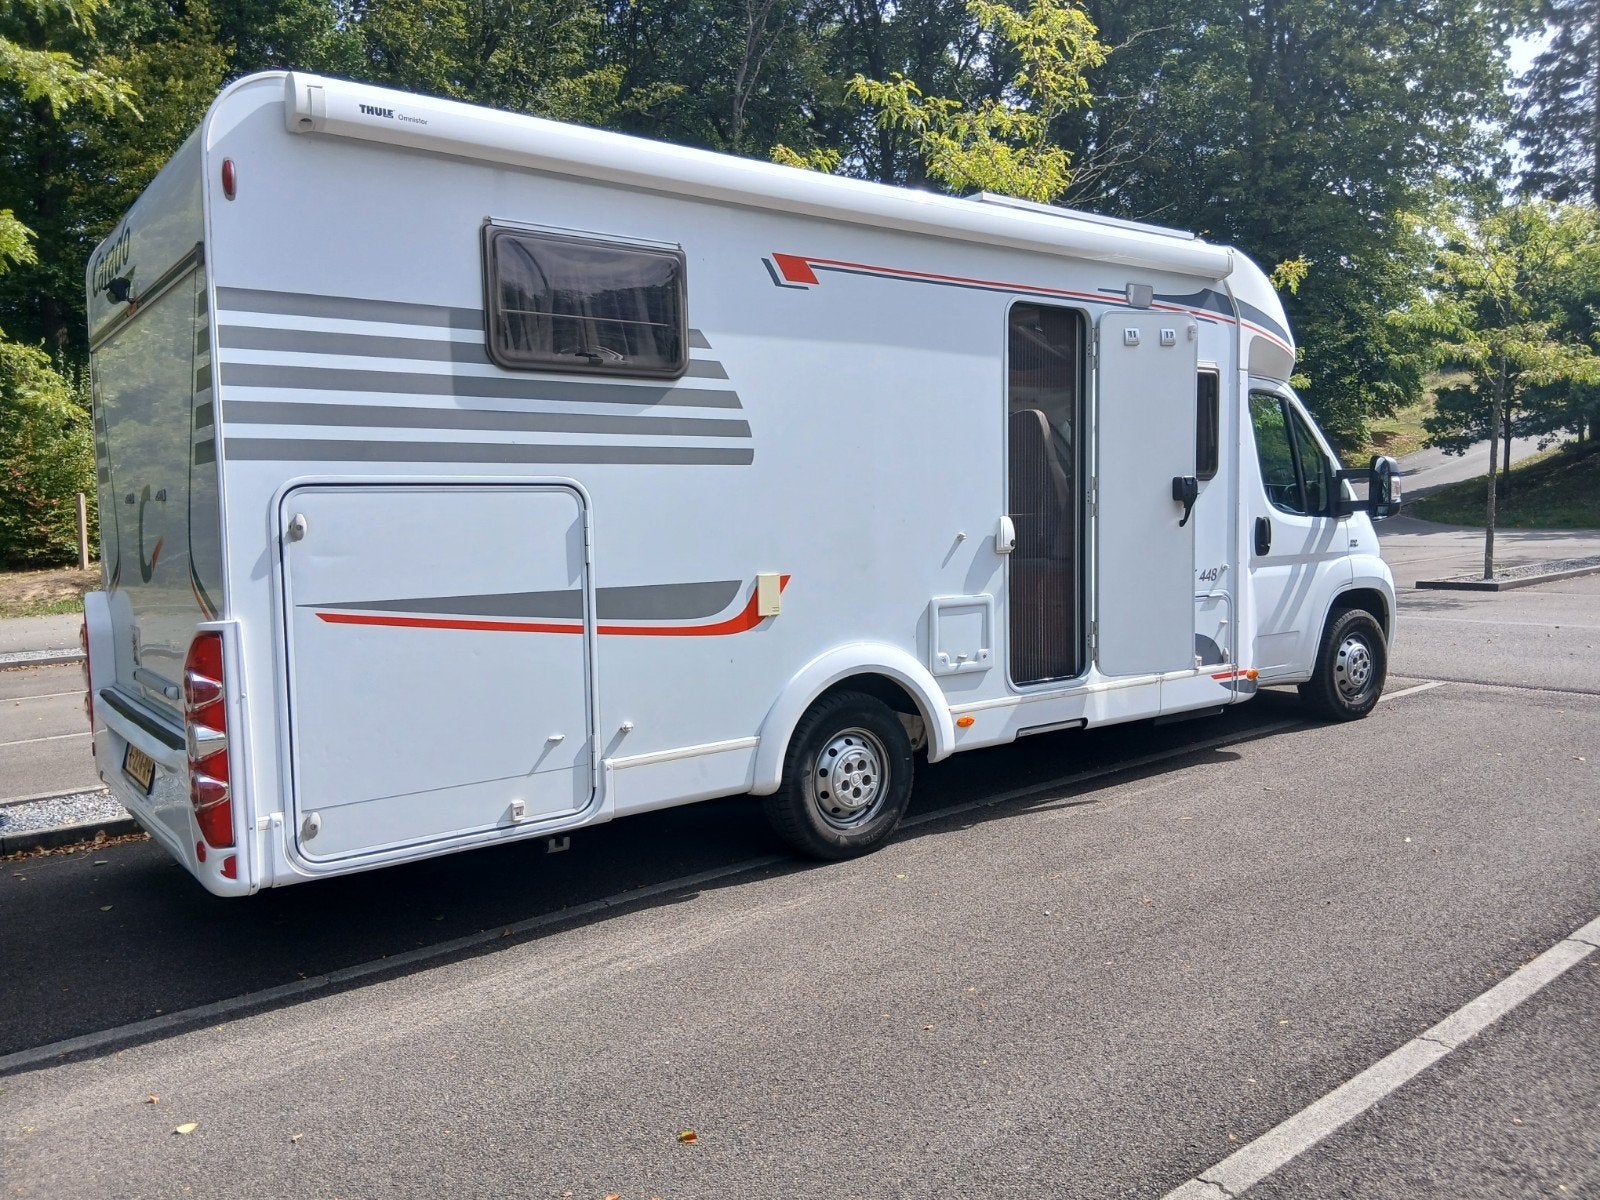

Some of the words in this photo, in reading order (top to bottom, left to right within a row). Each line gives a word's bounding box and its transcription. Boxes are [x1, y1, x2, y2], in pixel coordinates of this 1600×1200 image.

[359, 104, 395, 119] THULE
[397, 113, 428, 126] Omnistor
[92, 220, 131, 298] Carado
[1198, 567, 1218, 581] 448
